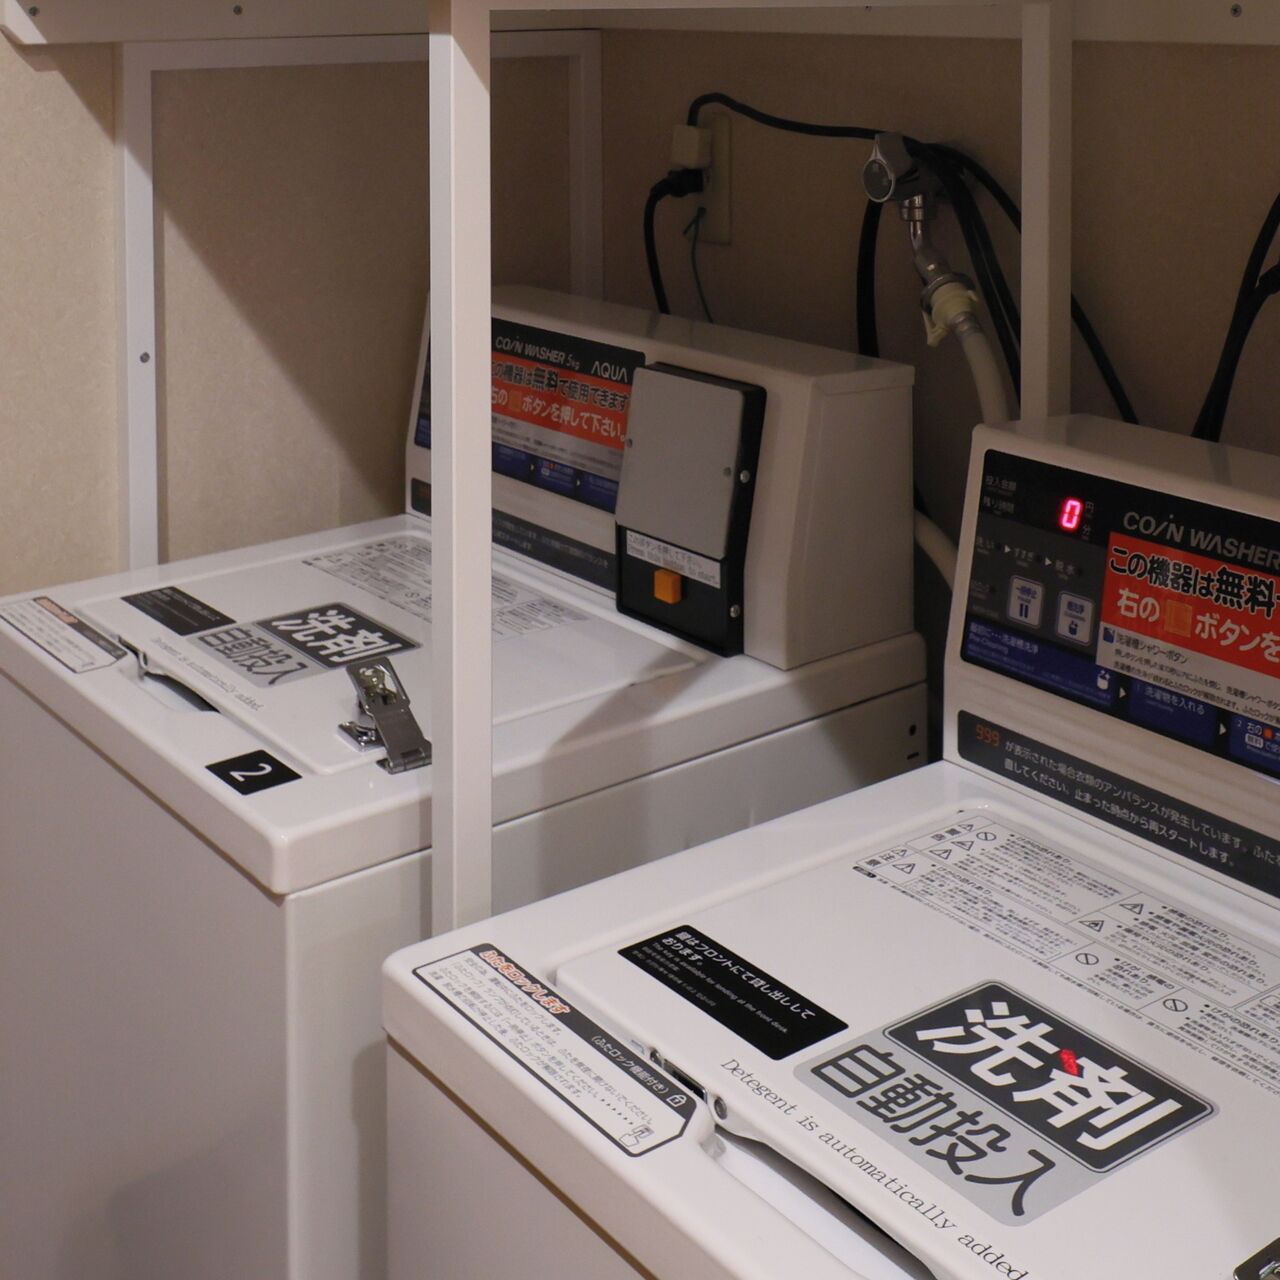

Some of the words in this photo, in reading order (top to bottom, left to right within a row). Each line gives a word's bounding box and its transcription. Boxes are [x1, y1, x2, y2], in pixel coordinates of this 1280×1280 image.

[525, 343, 565, 364] WASHER
[591, 360, 628, 383] AQUA
[1061, 498, 1081, 529] 0
[1117, 588, 1160, 624] 右の
[198, 627, 308, 685] 自動投入
[272, 609, 401, 663] 洗剤
[230, 762, 272, 782] 2
[661, 937, 704, 966] おります。
[675, 931, 816, 1020] 鍵はフロントにて貸し出しして
[480, 950, 570, 1014] ふたをロックします
[916, 1001, 1182, 1150] 洗剤
[720, 1059, 797, 1116] Detegent
[796, 1115, 820, 1132] is
[818, 1133, 958, 1231] automatically
[809, 1044, 1056, 1216] 自動投入
